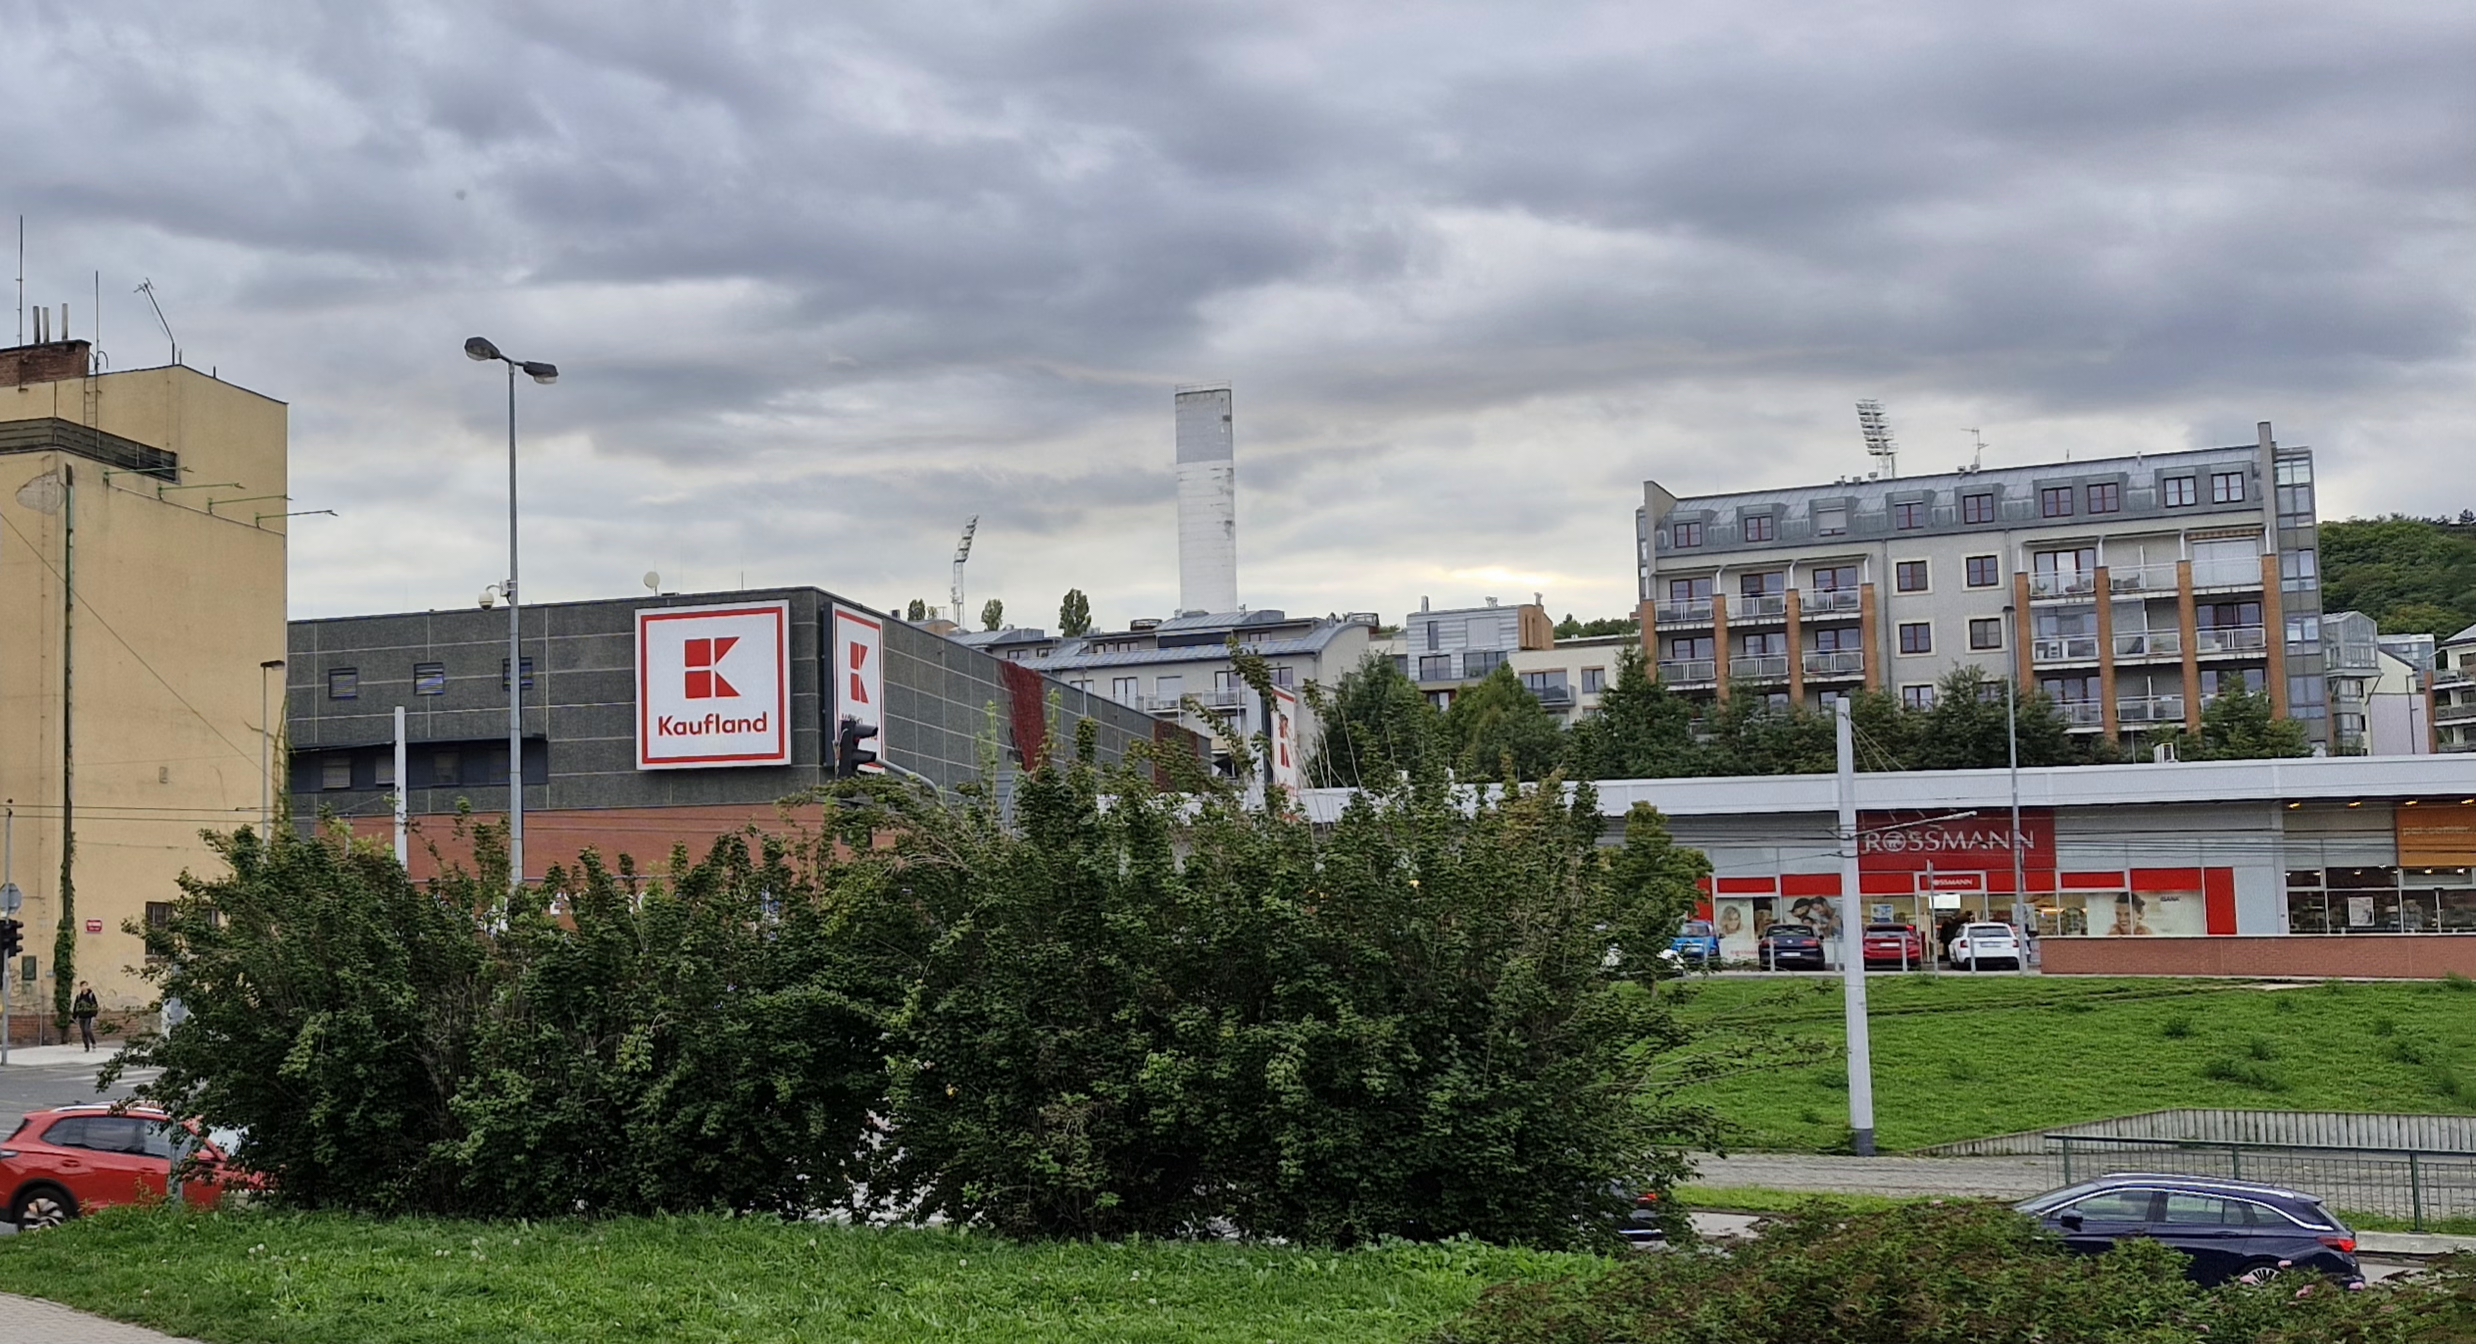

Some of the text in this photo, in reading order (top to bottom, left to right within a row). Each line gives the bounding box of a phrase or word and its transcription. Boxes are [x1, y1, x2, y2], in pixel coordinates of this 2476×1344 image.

[658, 711, 768, 736] Kaufland
[1860, 830, 2034, 854] ROSSMANN
[1929, 878, 1973, 886] OSSMANN
